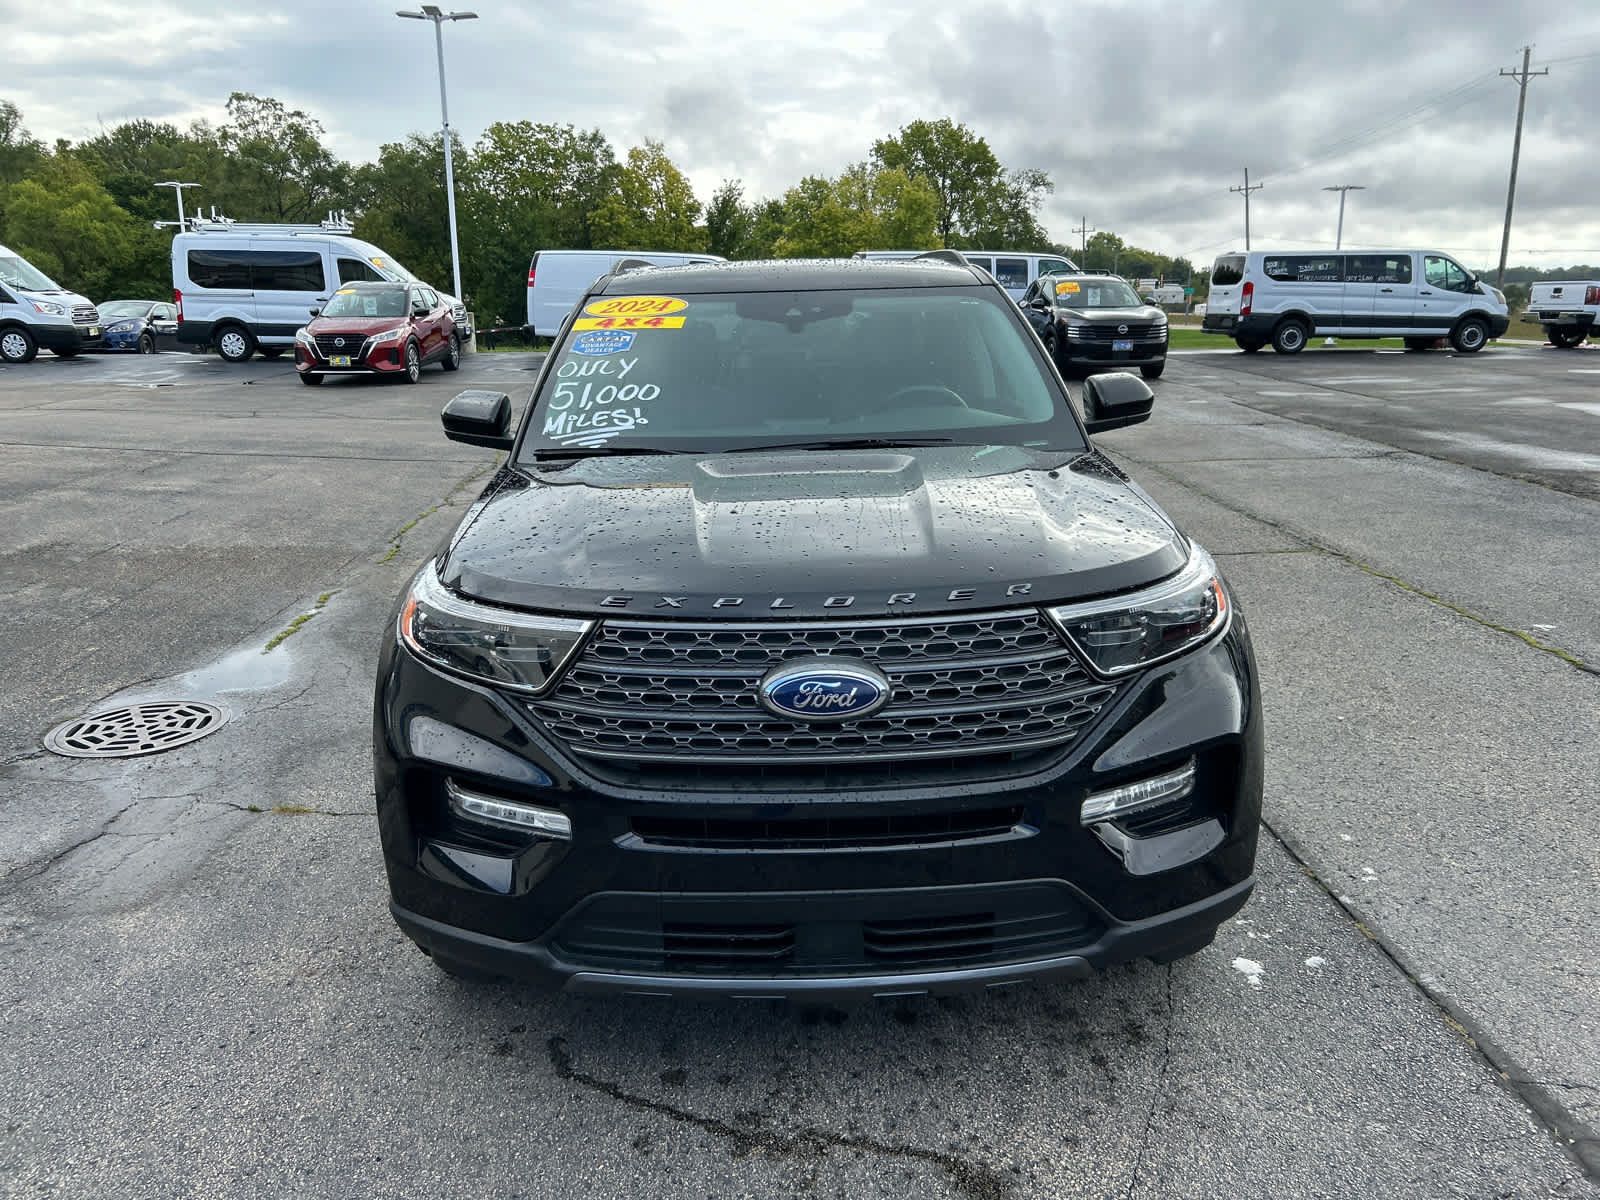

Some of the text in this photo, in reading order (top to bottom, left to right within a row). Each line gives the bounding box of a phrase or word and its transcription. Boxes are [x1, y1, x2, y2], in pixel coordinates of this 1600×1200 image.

[599, 300, 673, 314] 2024
[557, 358, 638, 379] ONLY
[549, 383, 661, 410] 51,000
[600, 583, 1032, 609] EXPLORER
[793, 680, 858, 709] Ford
